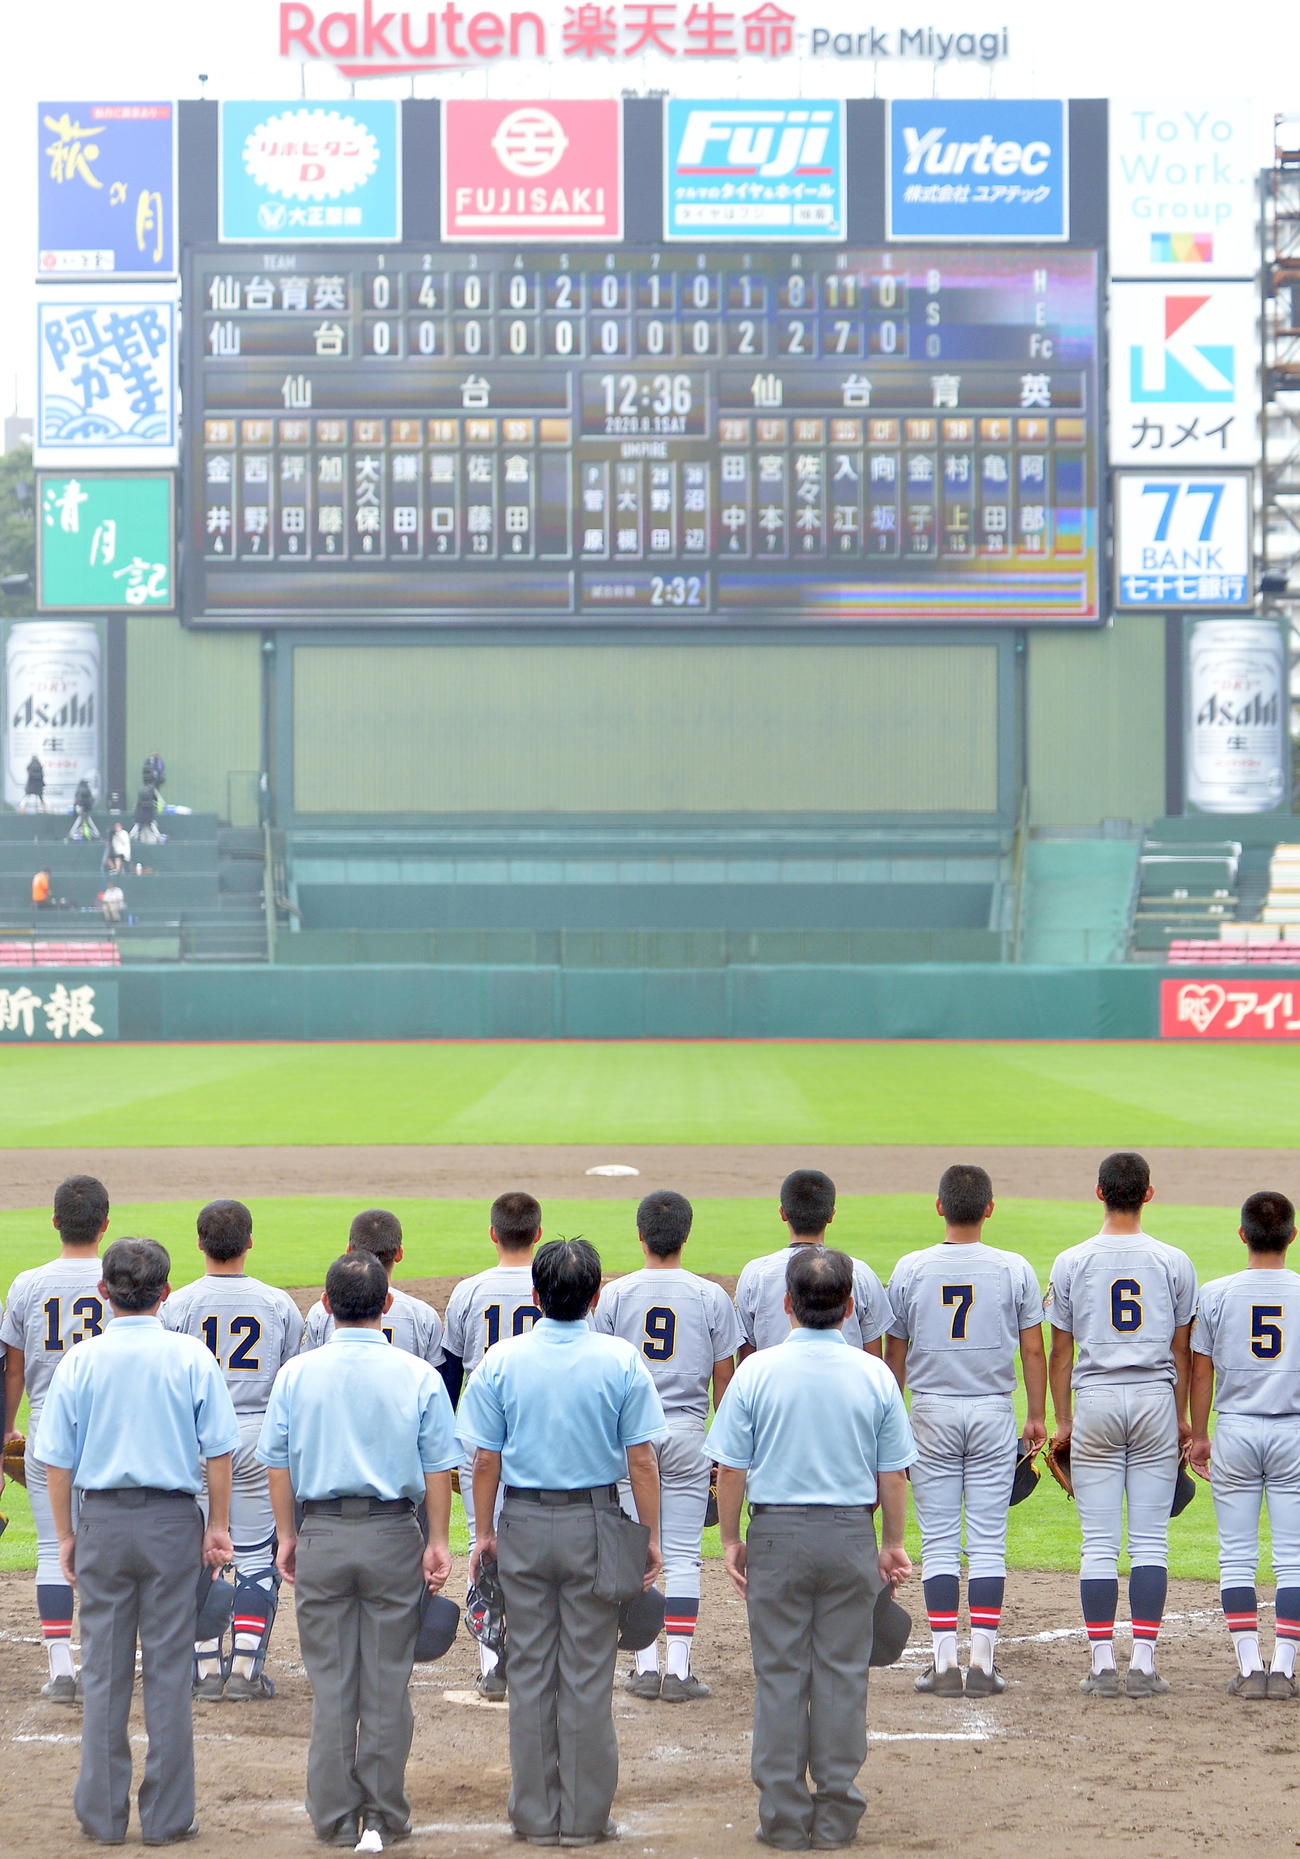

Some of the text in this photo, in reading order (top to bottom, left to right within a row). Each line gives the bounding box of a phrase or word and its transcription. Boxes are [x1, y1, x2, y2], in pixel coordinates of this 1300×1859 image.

[280, 0, 1008, 61] Rakuten 楽天生命 Park Miyagi
[1131, 110, 1233, 142] ToYo
[259, 141, 361, 156] リポビタン
[676, 110, 834, 177] Fuji
[903, 127, 1051, 176] Yurtec
[299, 163, 326, 182] D
[1120, 152, 1246, 185] Work.
[455, 187, 604, 213] FUJISAKI
[972, 185, 1052, 203] ユアテック
[1130, 195, 1233, 225] Group
[264, 255, 296, 270] TEAM
[378, 254, 385, 270] 1
[423, 254, 432, 270] 2
[209, 276, 345, 309] 仙台育英
[374, 275, 389, 309] 0
[418, 275, 436, 309] 4
[465, 275, 480, 309] 0
[510, 275, 526, 309] 0
[556, 275, 572, 309] 2
[602, 275, 618, 309] 0
[648, 275, 660, 309] 1
[693, 275, 709, 309] 0
[739, 275, 752, 309] 1
[826, 275, 856, 309] 11
[880, 275, 896, 309] 0
[926, 302, 940, 326] S
[1035, 303, 1046, 327] E
[374, 321, 389, 354] 0
[418, 321, 436, 354] 0
[465, 321, 480, 354] 0
[510, 321, 526, 354] 0
[556, 321, 572, 354] 0
[602, 321, 618, 354] 0
[648, 321, 664, 354] 0
[693, 321, 709, 354] 0
[738, 321, 754, 354] 2
[788, 321, 804, 354] 2
[834, 321, 851, 354] 7
[880, 321, 896, 354] 0
[1030, 334, 1053, 359] Fc
[600, 374, 692, 415] 12:36
[621, 441, 668, 458] UMPIRE
[1131, 416, 1235, 450] カメイ
[206, 455, 230, 533] 金井
[355, 455, 380, 533] 大久保
[722, 454, 746, 532] 田中
[795, 454, 821, 532] 佐々木
[908, 454, 933, 532] 金子
[944, 454, 970, 532] 村上
[1142, 483, 1226, 542] 77
[44, 479, 167, 605] 清月記
[1142, 547, 1223, 570] BANK
[651, 576, 700, 605] 2:32
[1125, 576, 1244, 601] 七十七銀行
[14, 692, 94, 728] Asahi
[1197, 690, 1278, 726] Asahi
[43, 737, 65, 751] 生
[1227, 735, 1248, 750] 生
[941, 1284, 975, 1340] 7
[1110, 1277, 1144, 1334] 6
[44, 1296, 104, 1352] 13
[642, 1305, 678, 1362] 9
[1249, 1304, 1284, 1360] 5
[201, 1315, 263, 1372] 12
